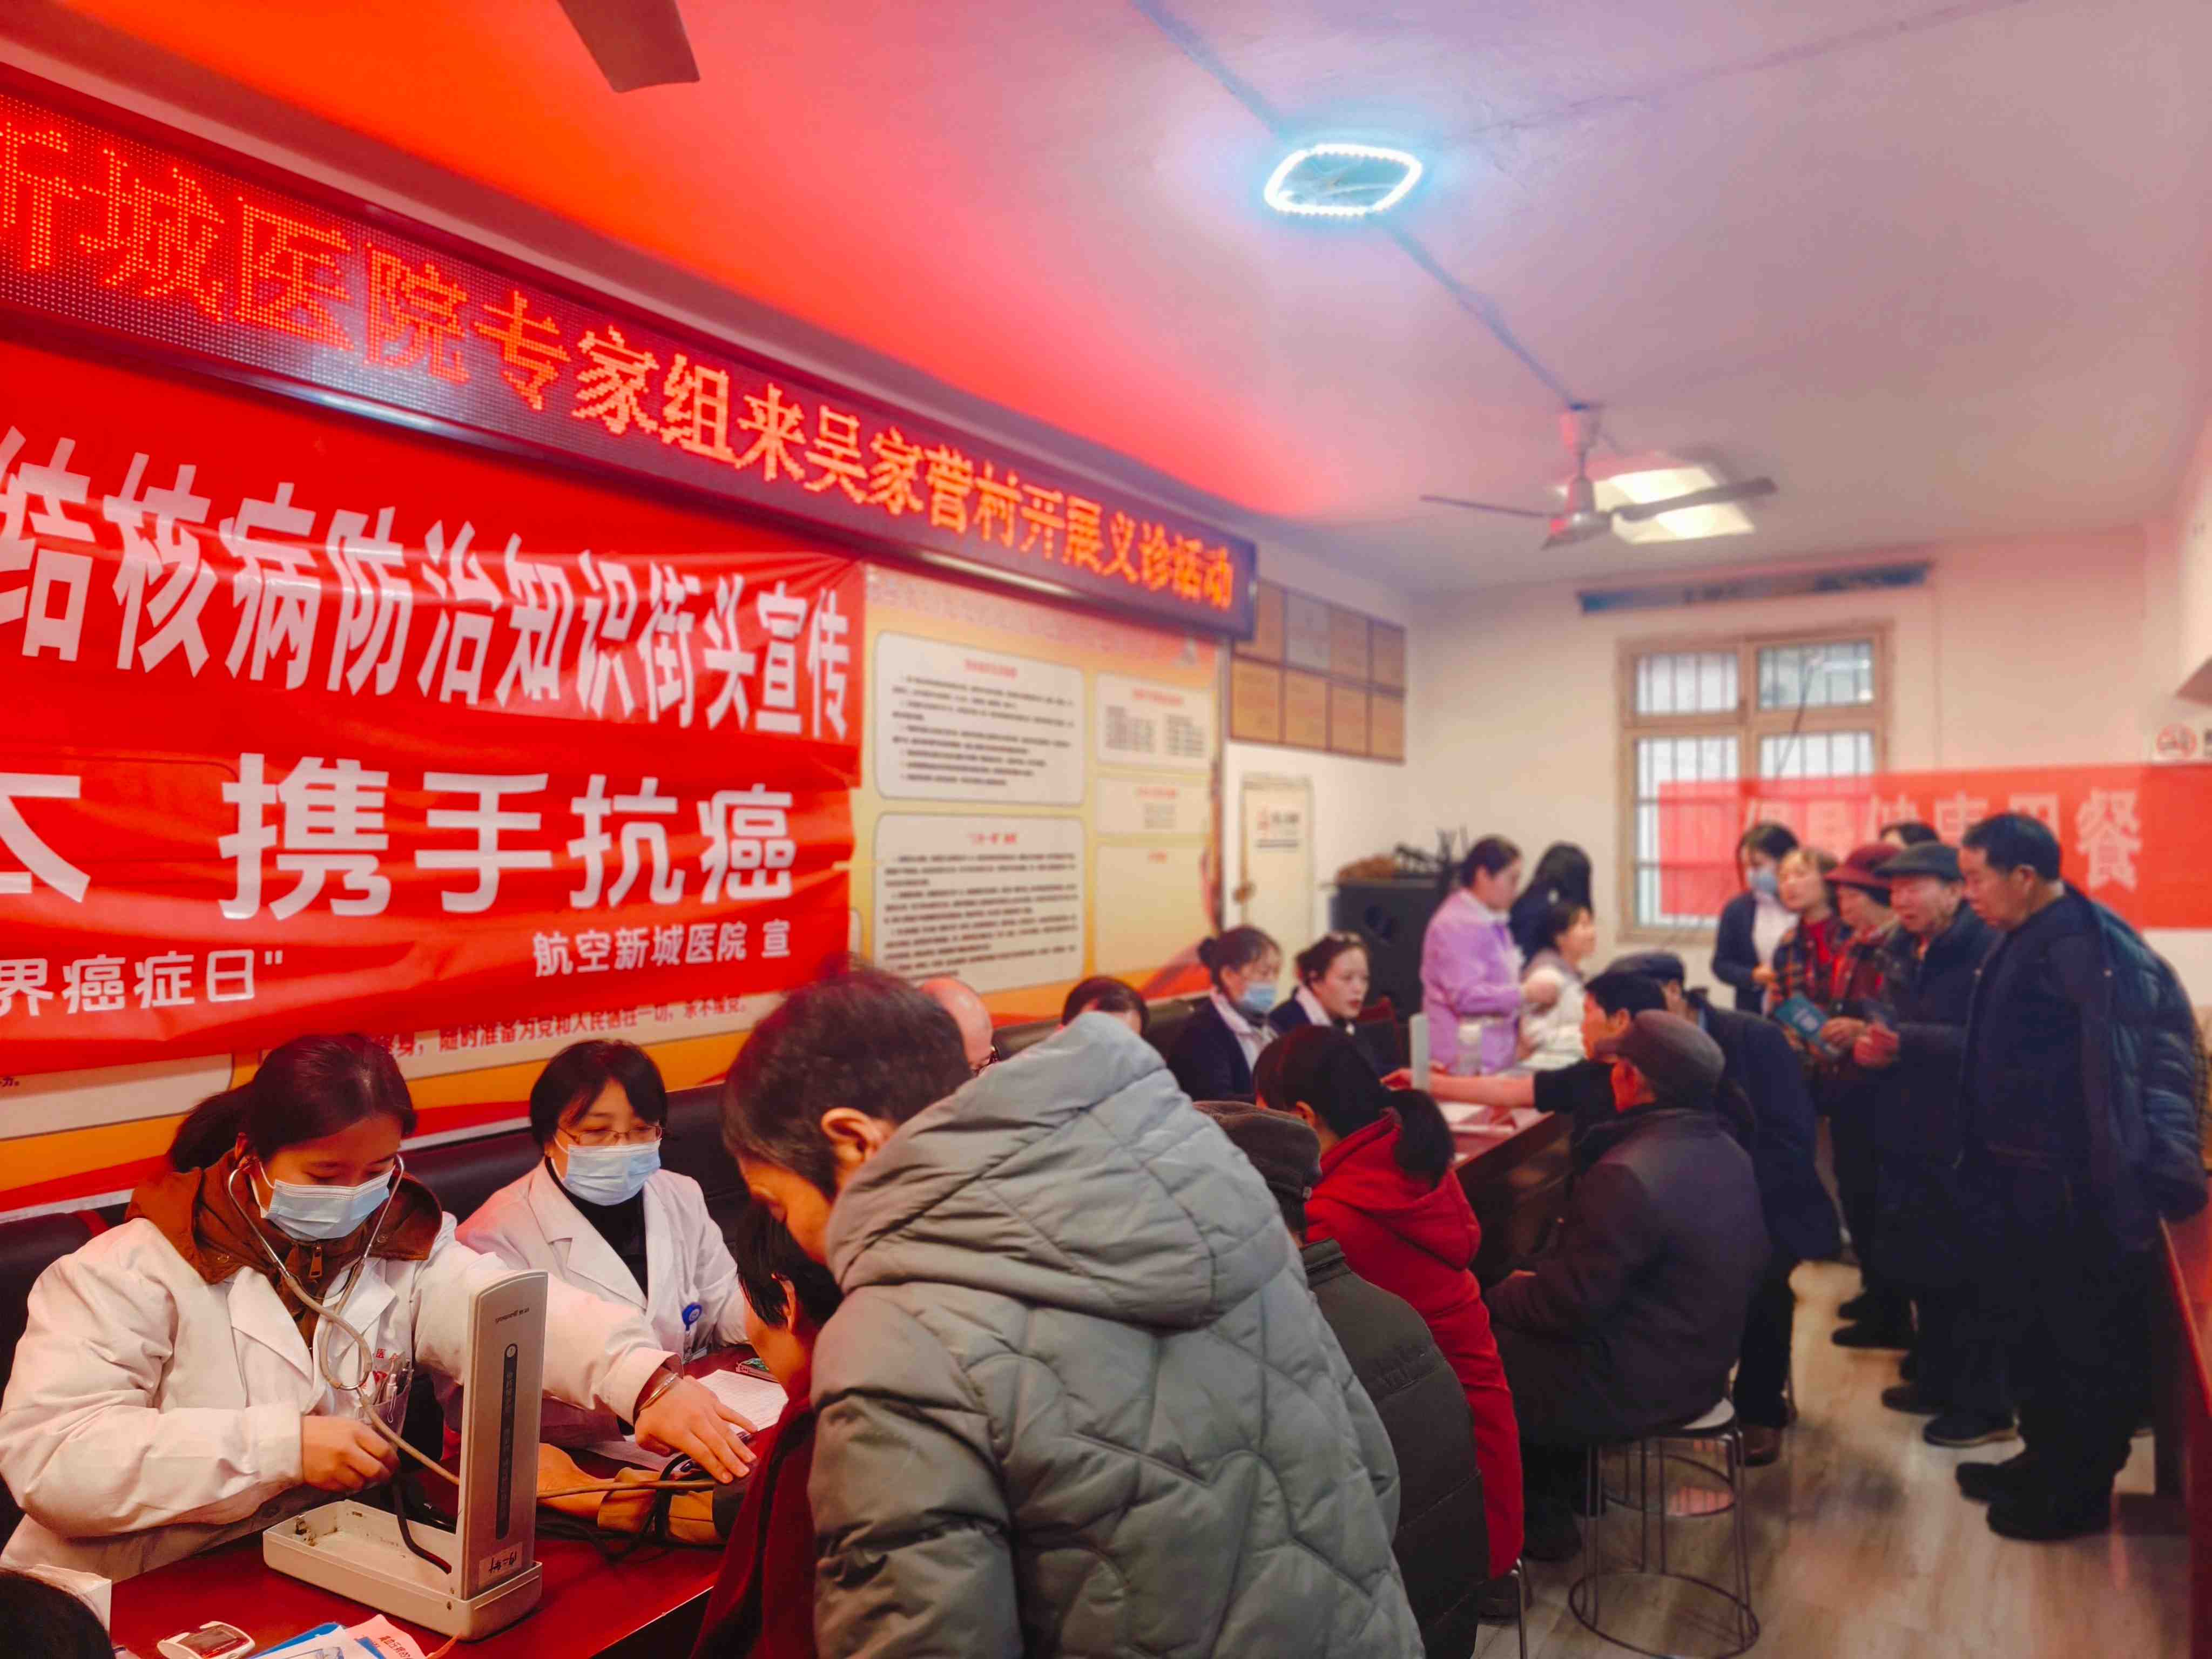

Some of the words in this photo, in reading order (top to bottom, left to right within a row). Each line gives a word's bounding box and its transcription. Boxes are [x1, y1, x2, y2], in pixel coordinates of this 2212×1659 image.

[0, 426, 849, 740] 结核病防治知识街头宣传
[218, 752, 797, 920] 携手抗癌
[533, 921, 747, 976] 航空新城医院
[761, 919, 791, 958] 宣
